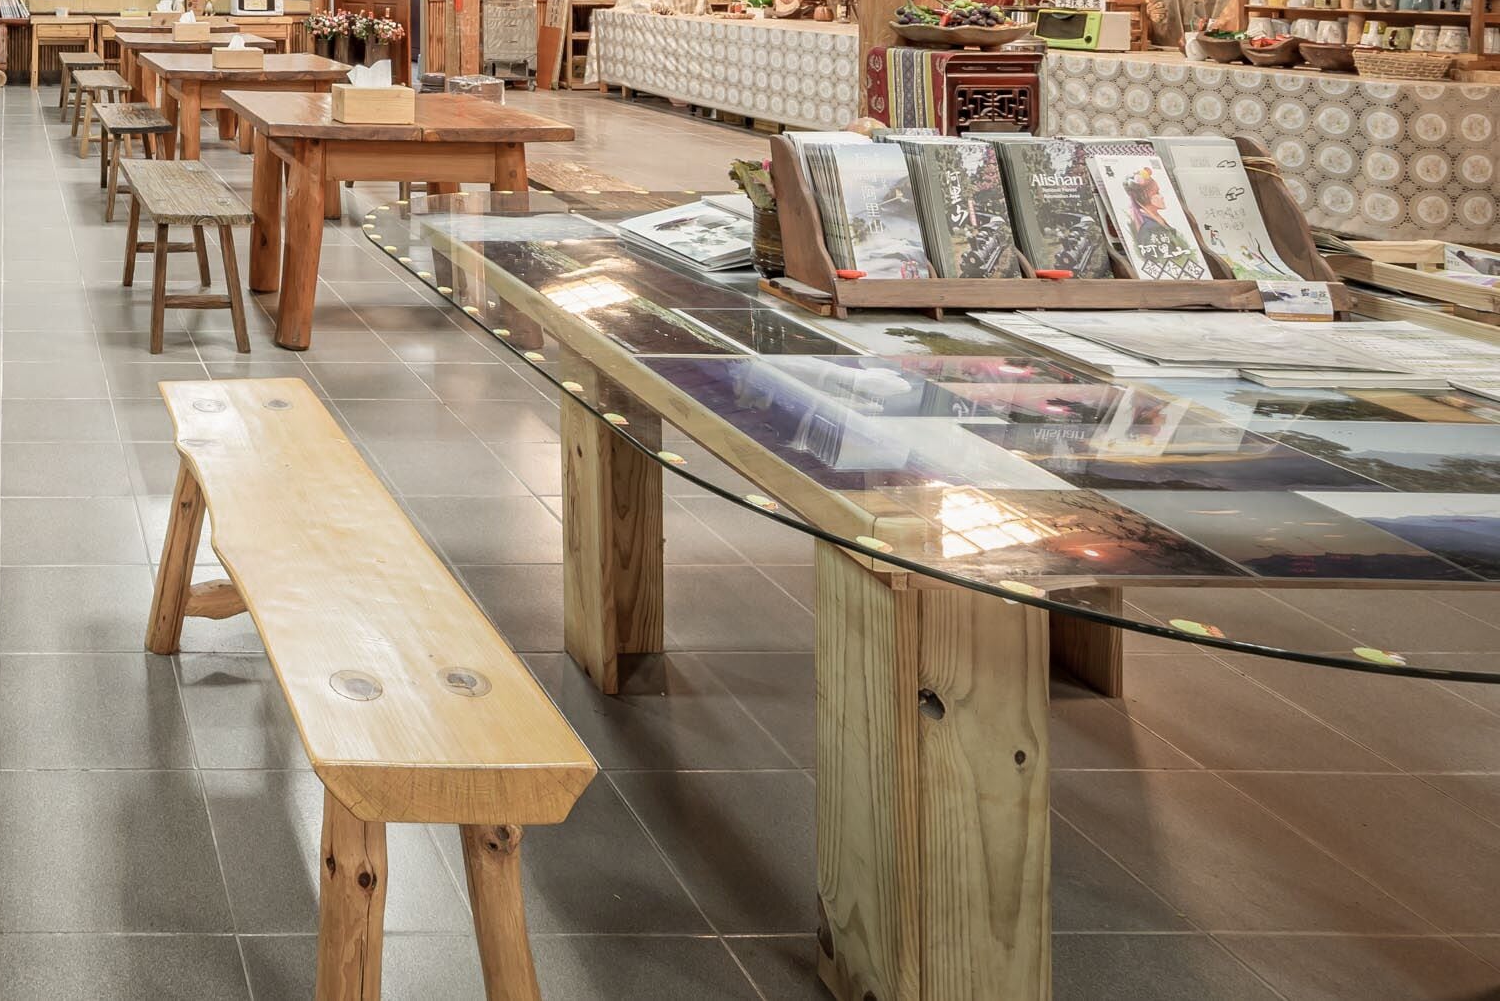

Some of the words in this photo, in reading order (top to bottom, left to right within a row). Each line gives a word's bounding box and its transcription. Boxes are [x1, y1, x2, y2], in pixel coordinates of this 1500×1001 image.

[1031, 174, 1083, 186] Alishan
[946, 171, 968, 226] 阿里山
[1138, 244, 1191, 258] 阿里山
